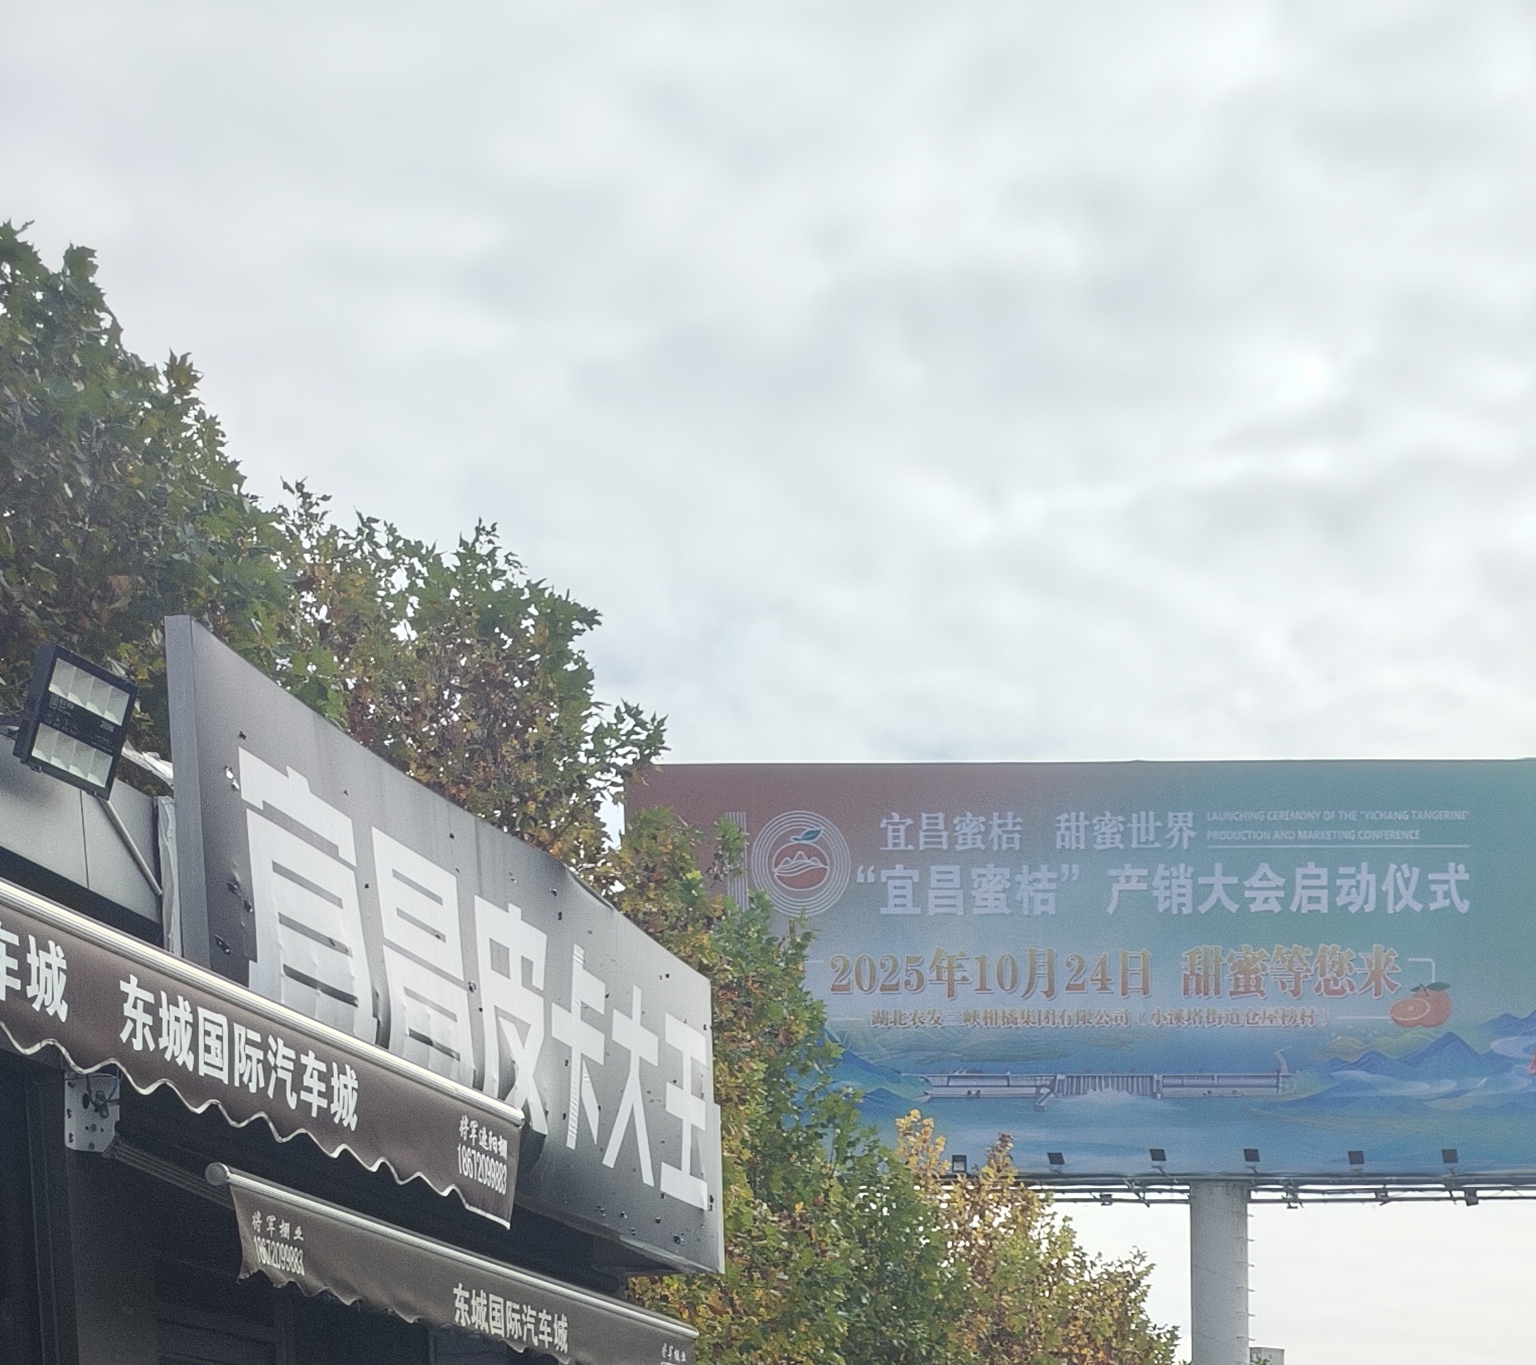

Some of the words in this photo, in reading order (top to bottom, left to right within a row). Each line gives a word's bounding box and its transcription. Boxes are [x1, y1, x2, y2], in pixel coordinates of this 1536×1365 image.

[880, 812, 1023, 851] 宜昌蜜桔
[1054, 811, 1197, 851] 甜蜜世界
[1207, 811, 1264, 821] LAUNCHING
[1267, 811, 1320, 821] CEREMONY
[1323, 811, 1336, 821] OF
[1339, 811, 1356, 821] THE
[1207, 830, 1270, 840] PRODUCTION
[1273, 830, 1295, 840] AND
[1298, 830, 1355, 840] MARKETING
[1358, 830, 1421, 840] CONFERENCE
[238, 746, 708, 1212] 宜昌皮卡大王
[829, 947, 1151, 999] 2025年10月24日
[1182, 944, 1401, 999] 甜蜜等您来
[120, 974, 359, 1131] 东城国际汽车城
[453, 1283, 568, 1354] 东城国际汽车城
